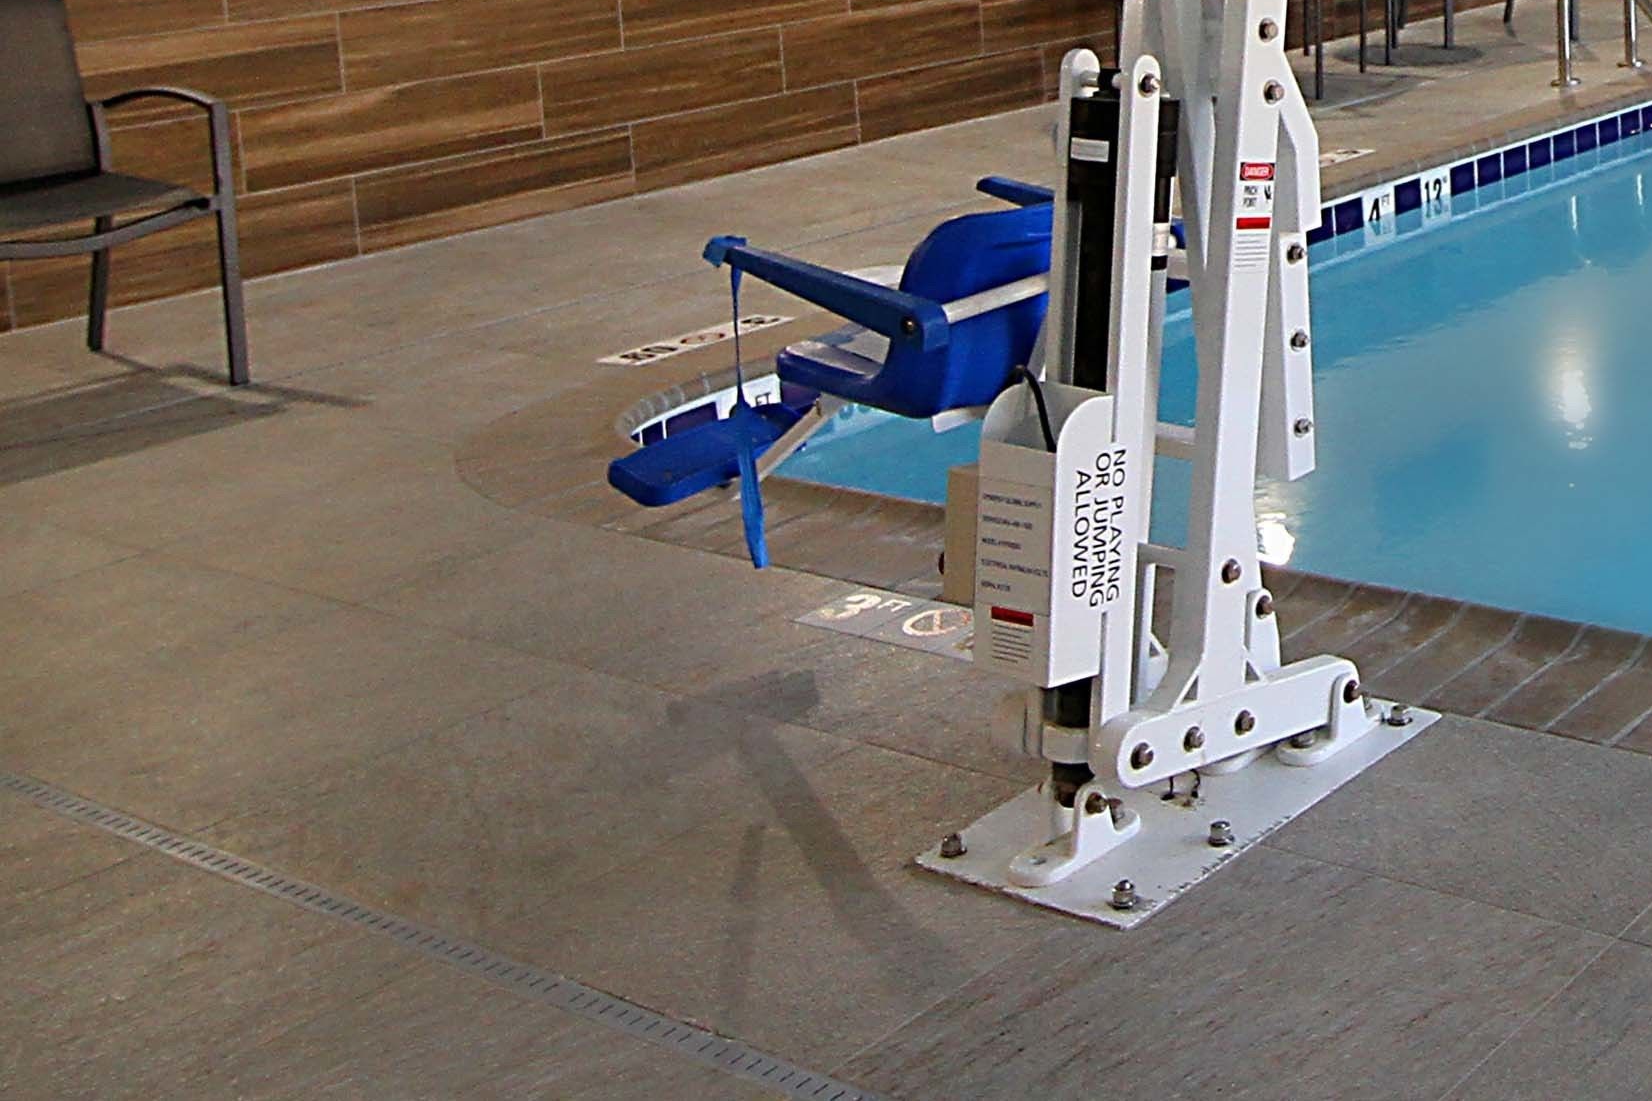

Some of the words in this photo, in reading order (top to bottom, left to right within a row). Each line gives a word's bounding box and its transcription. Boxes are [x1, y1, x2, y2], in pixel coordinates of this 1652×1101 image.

[1094, 452, 1112, 488] OR
[1112, 449, 1127, 488] NO
[1071, 470, 1092, 598] ALLOWED
[1089, 497, 1109, 608] JUMPING
[1105, 495, 1125, 603] PLAYING
